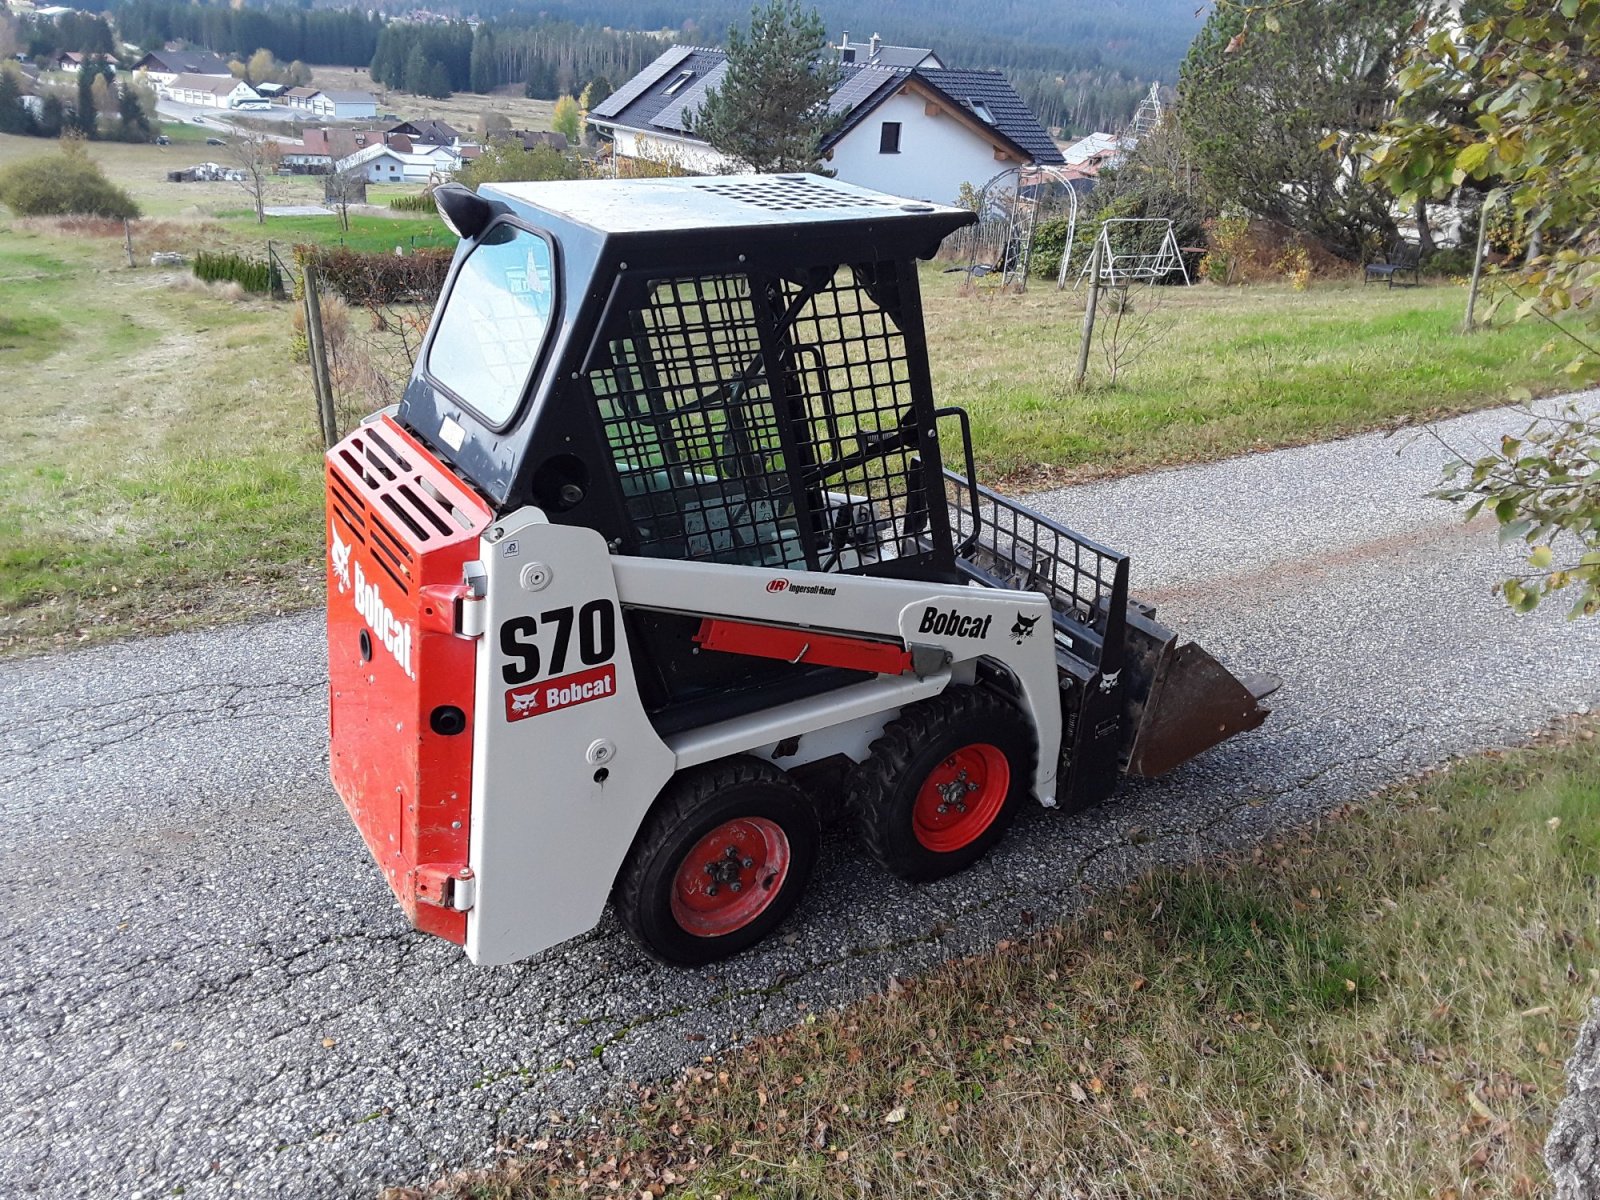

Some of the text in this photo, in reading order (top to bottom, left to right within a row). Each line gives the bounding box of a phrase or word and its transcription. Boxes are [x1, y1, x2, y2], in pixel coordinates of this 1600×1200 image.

[768, 579, 787, 592] IR
[354, 560, 412, 677] Bobcat
[918, 606, 992, 639] Bobcat
[499, 599, 616, 685] S70
[546, 674, 612, 709] Bobcat
